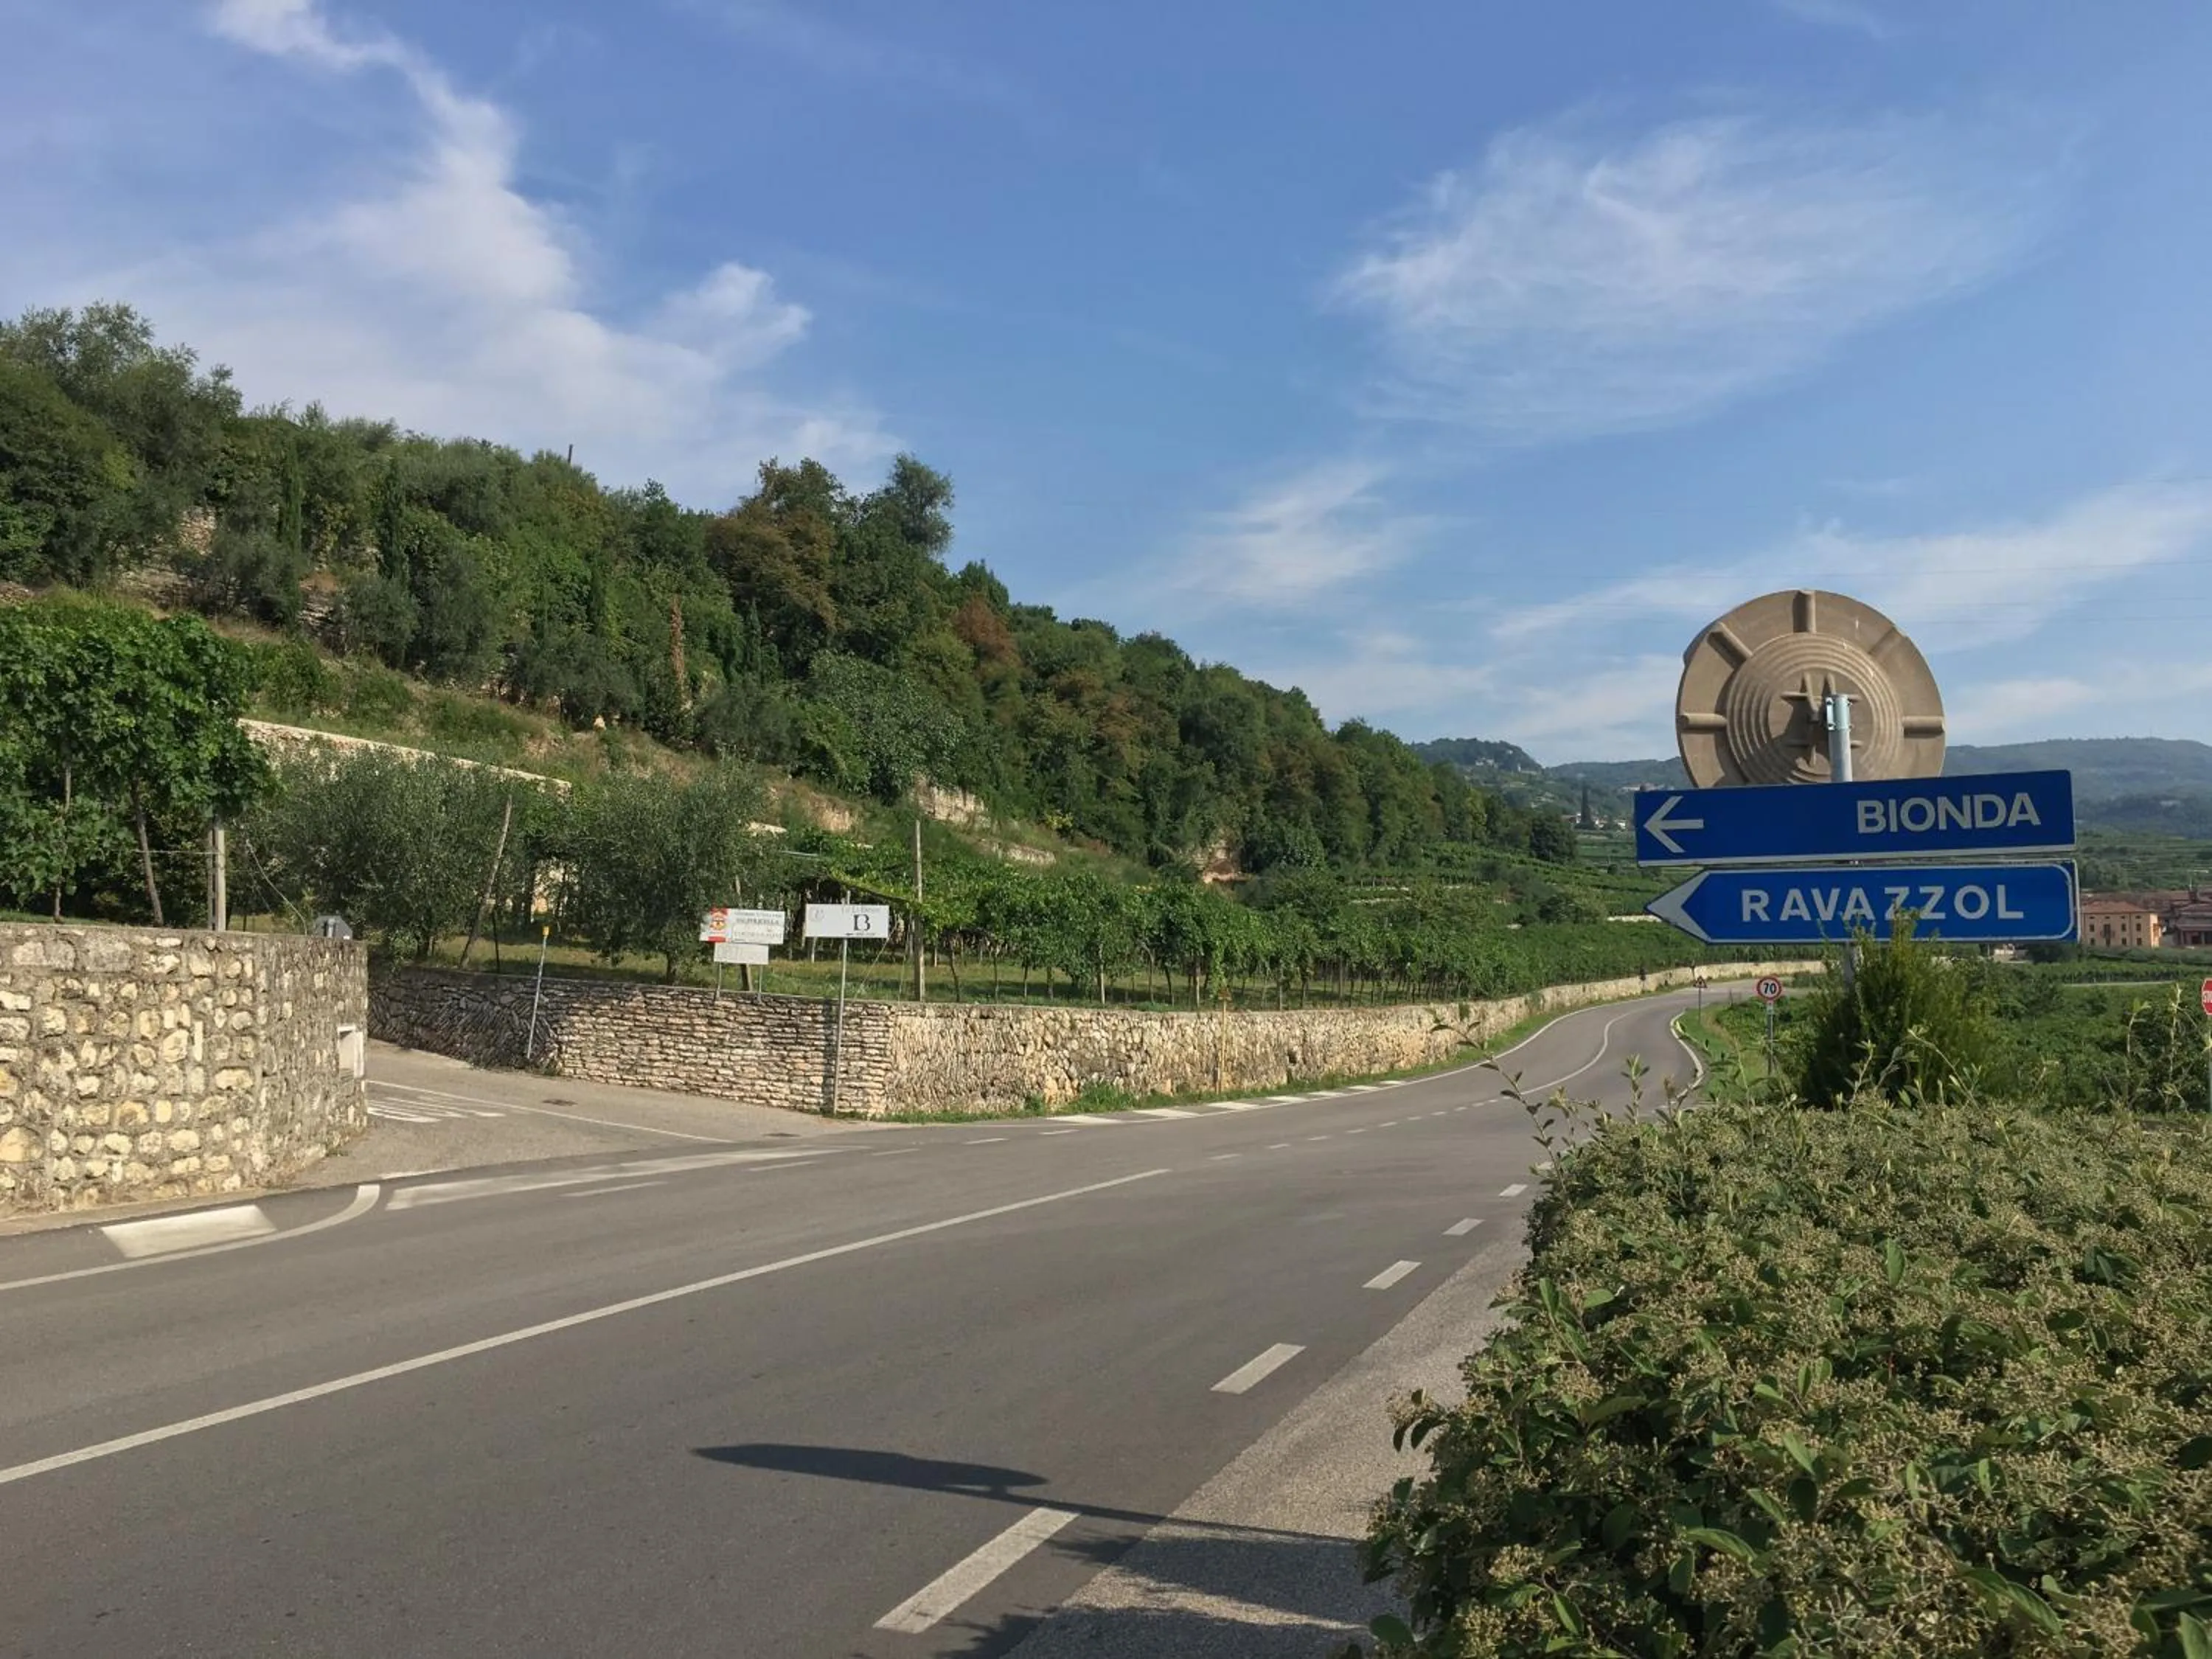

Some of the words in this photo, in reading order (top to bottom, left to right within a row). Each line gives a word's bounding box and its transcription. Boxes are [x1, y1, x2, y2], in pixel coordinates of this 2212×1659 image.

[1857, 793, 2041, 833] BIONDA
[1741, 884, 2025, 922] RAVAZZOL
[1764, 983, 1776, 994] 70
